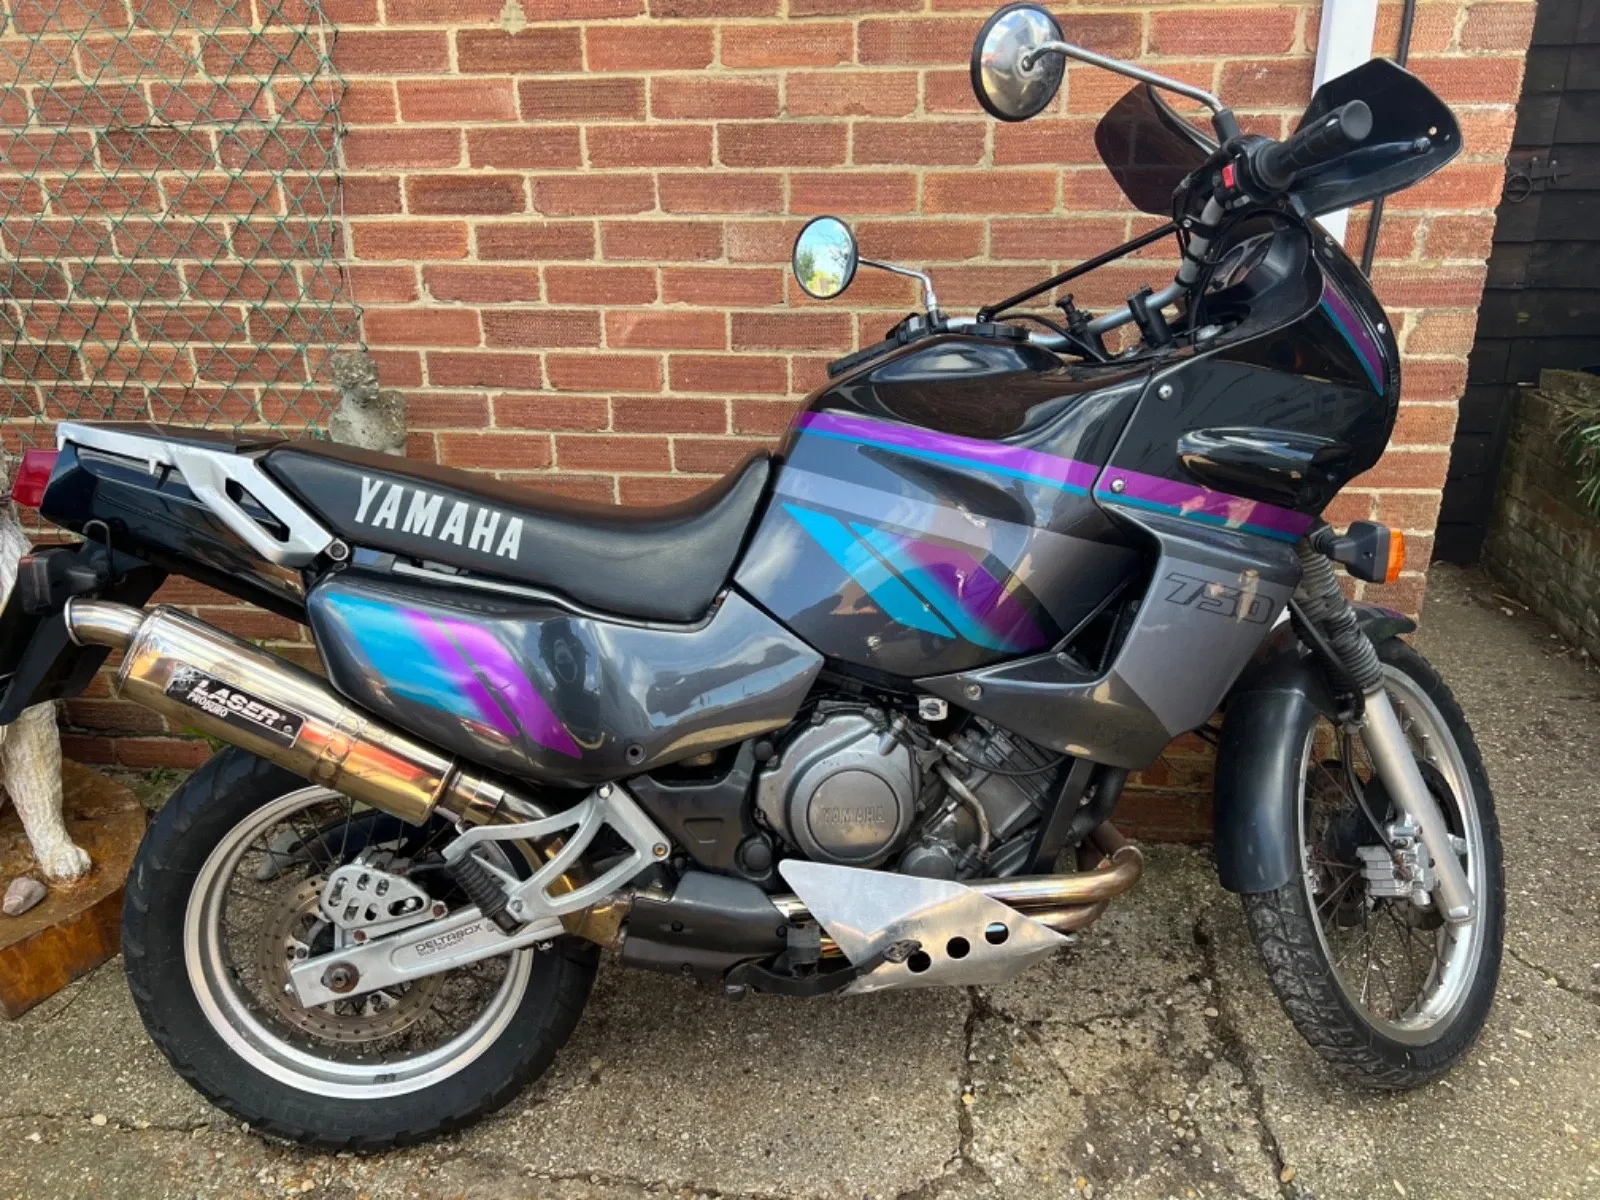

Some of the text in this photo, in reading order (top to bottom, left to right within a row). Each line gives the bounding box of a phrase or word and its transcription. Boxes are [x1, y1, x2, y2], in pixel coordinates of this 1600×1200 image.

[354, 476, 524, 561] YAMAHA
[1164, 572, 1275, 625] 750
[192, 679, 281, 727] LASER
[822, 805, 886, 824] YAMAHA
[415, 923, 482, 952] DELTABOX
